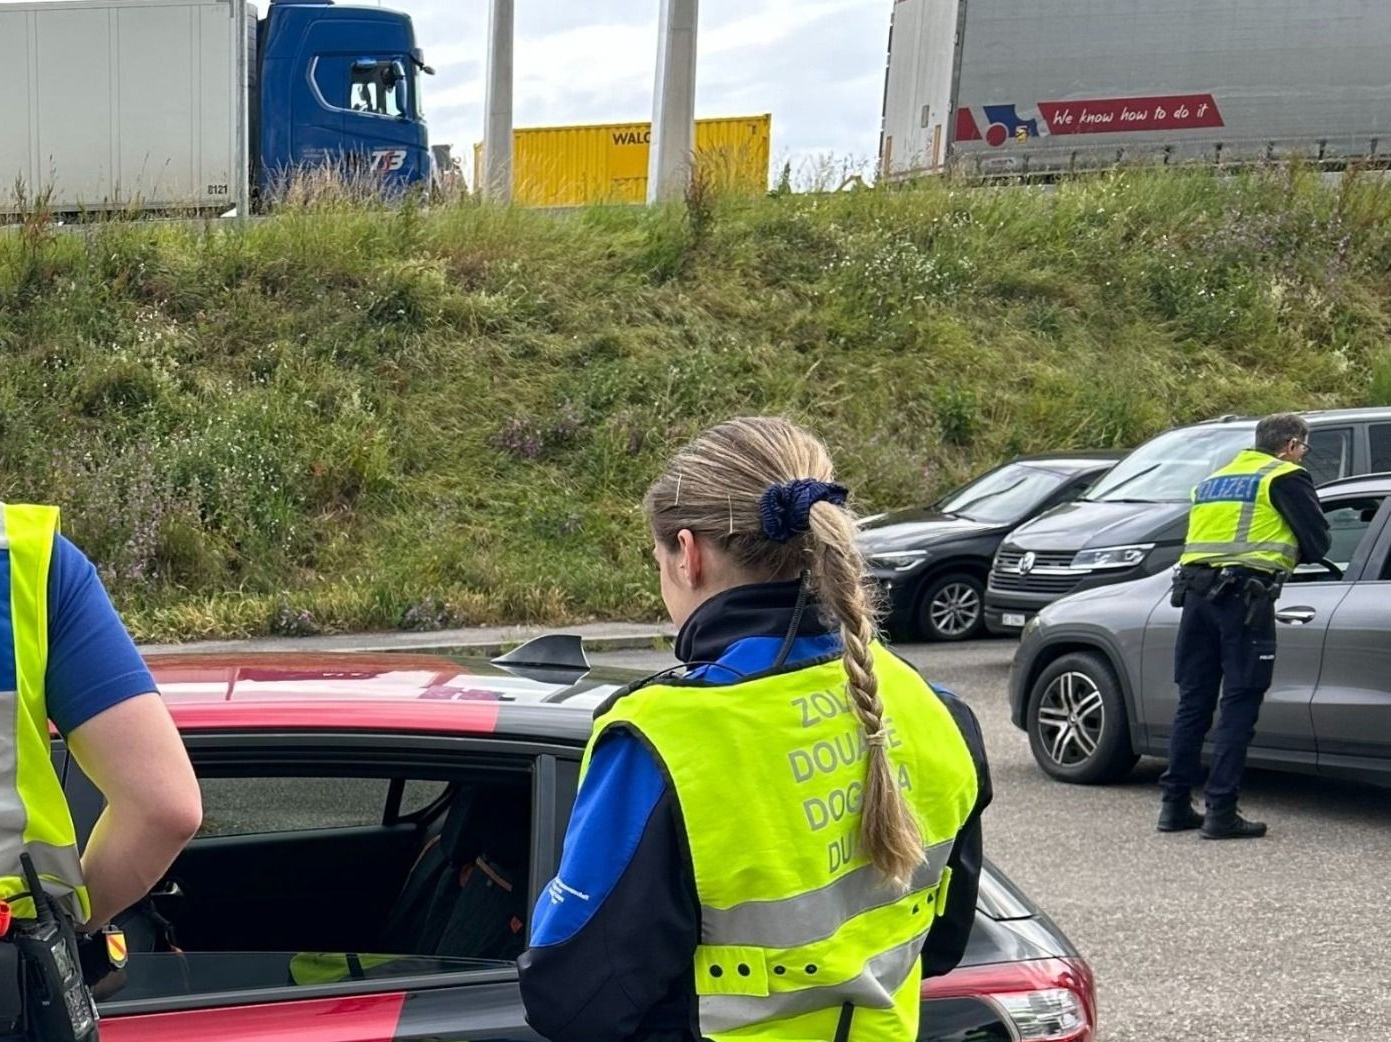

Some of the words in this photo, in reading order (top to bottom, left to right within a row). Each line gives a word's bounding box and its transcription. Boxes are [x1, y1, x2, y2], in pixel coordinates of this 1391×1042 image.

[1052, 109, 1073, 125] We
[1079, 106, 1114, 124] know
[1120, 105, 1148, 120] how
[1153, 105, 1167, 119] to
[1173, 104, 1190, 119] do
[1196, 104, 1209, 118] it
[1197, 476, 1256, 500] OLIZEI
[791, 688, 850, 728] ZOL
[788, 717, 902, 784] DOUAE
[803, 763, 912, 832] DOGA
